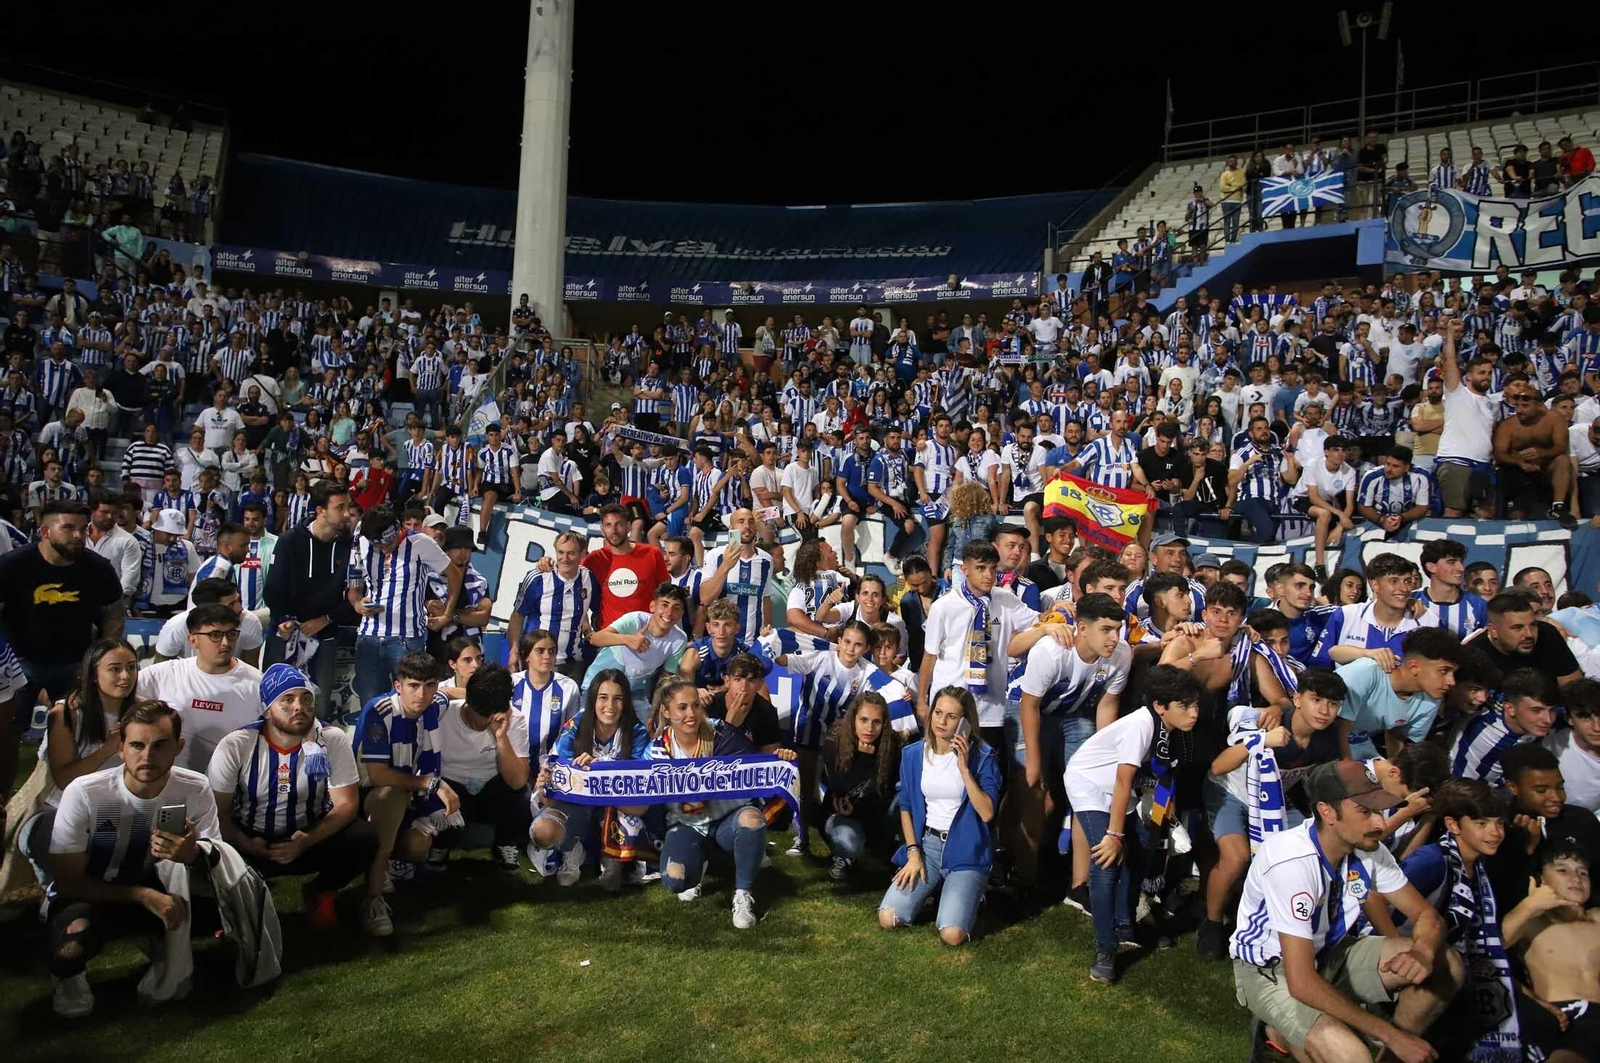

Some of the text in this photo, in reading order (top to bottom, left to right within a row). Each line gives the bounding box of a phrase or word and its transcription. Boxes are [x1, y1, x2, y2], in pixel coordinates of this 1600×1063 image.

[217, 251, 239, 260] alter
[216, 259, 255, 269] enersun
[275, 258, 297, 266] alter
[275, 266, 312, 275] enersun
[332, 271, 367, 280] enersun
[454, 275, 474, 283] alter
[404, 279, 438, 287] enersun
[454, 282, 488, 290] enersun
[617, 291, 650, 299] enersun
[1059, 486, 1082, 500] 18
[729, 584, 758, 595] Cajasol
[194, 701, 222, 710] LEVI'S
[651, 759, 743, 775] Real Club
[589, 766, 792, 795] RECREATIVO de HUELVA
